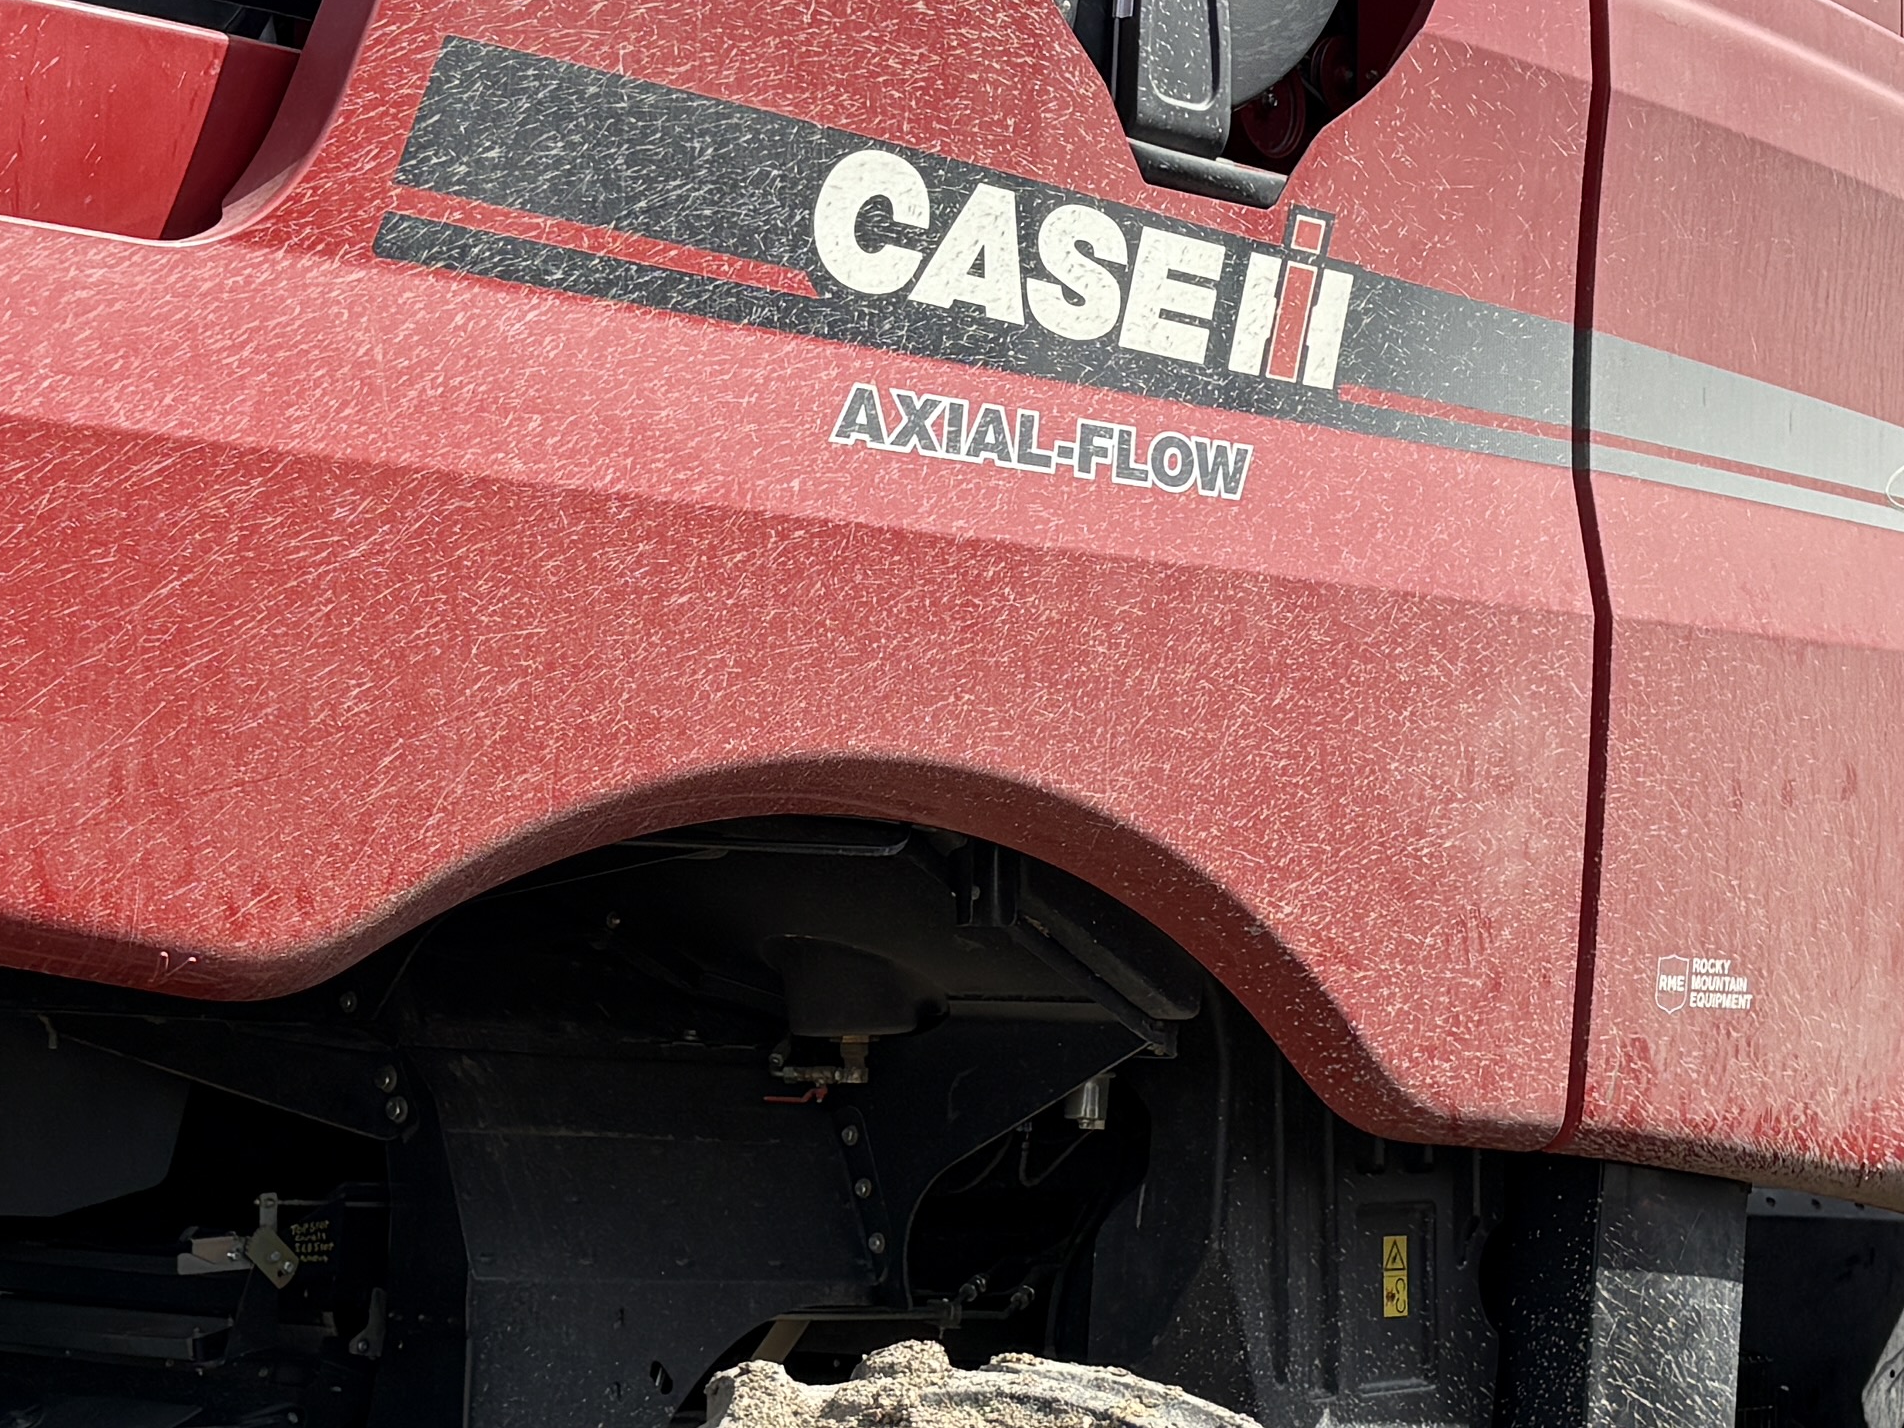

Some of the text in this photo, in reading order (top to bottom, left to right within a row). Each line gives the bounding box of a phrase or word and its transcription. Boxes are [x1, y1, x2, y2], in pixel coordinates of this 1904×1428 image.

[813, 149, 1224, 365] CASE
[828, 380, 1255, 501] AXIAL-FLOW
[1692, 957, 1731, 974] ROCKY
[1659, 974, 1685, 992] RME
[1691, 975, 1748, 992] MOUNTAIN
[1689, 992, 1753, 1010] EQUIPMENT
